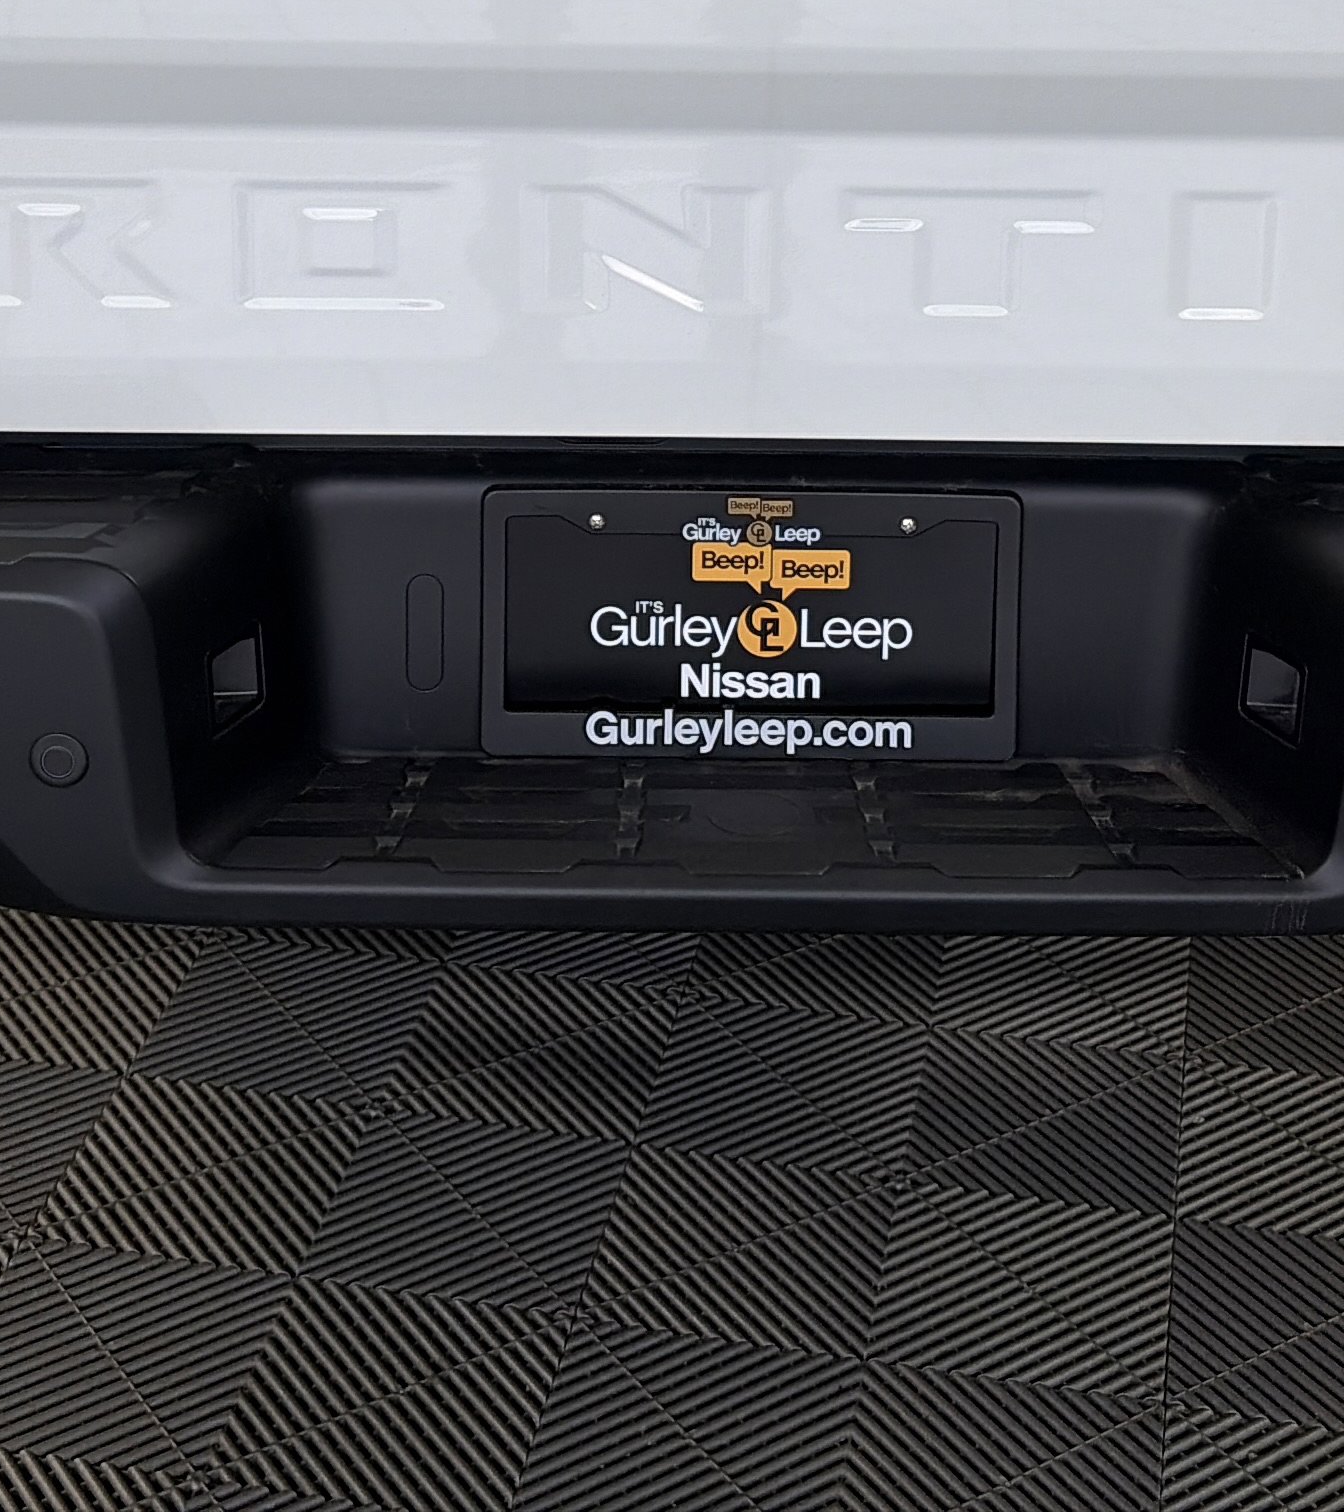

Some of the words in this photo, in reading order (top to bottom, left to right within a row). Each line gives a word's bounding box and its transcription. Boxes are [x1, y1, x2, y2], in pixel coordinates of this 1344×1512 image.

[697, 517, 717, 527] IT'S
[729, 500, 759, 512] Beep!
[762, 503, 792, 515] Beep!
[682, 522, 743, 546] Gurley
[774, 524, 821, 546] Leep
[701, 550, 765, 575] Beep!
[781, 559, 845, 584] Beep!
[635, 600, 664, 614] IT'S
[590, 603, 737, 658] Gurley
[799, 608, 913, 660] Leep
[679, 662, 820, 699] Nissan
[585, 708, 913, 755] Gurleyleep.com
